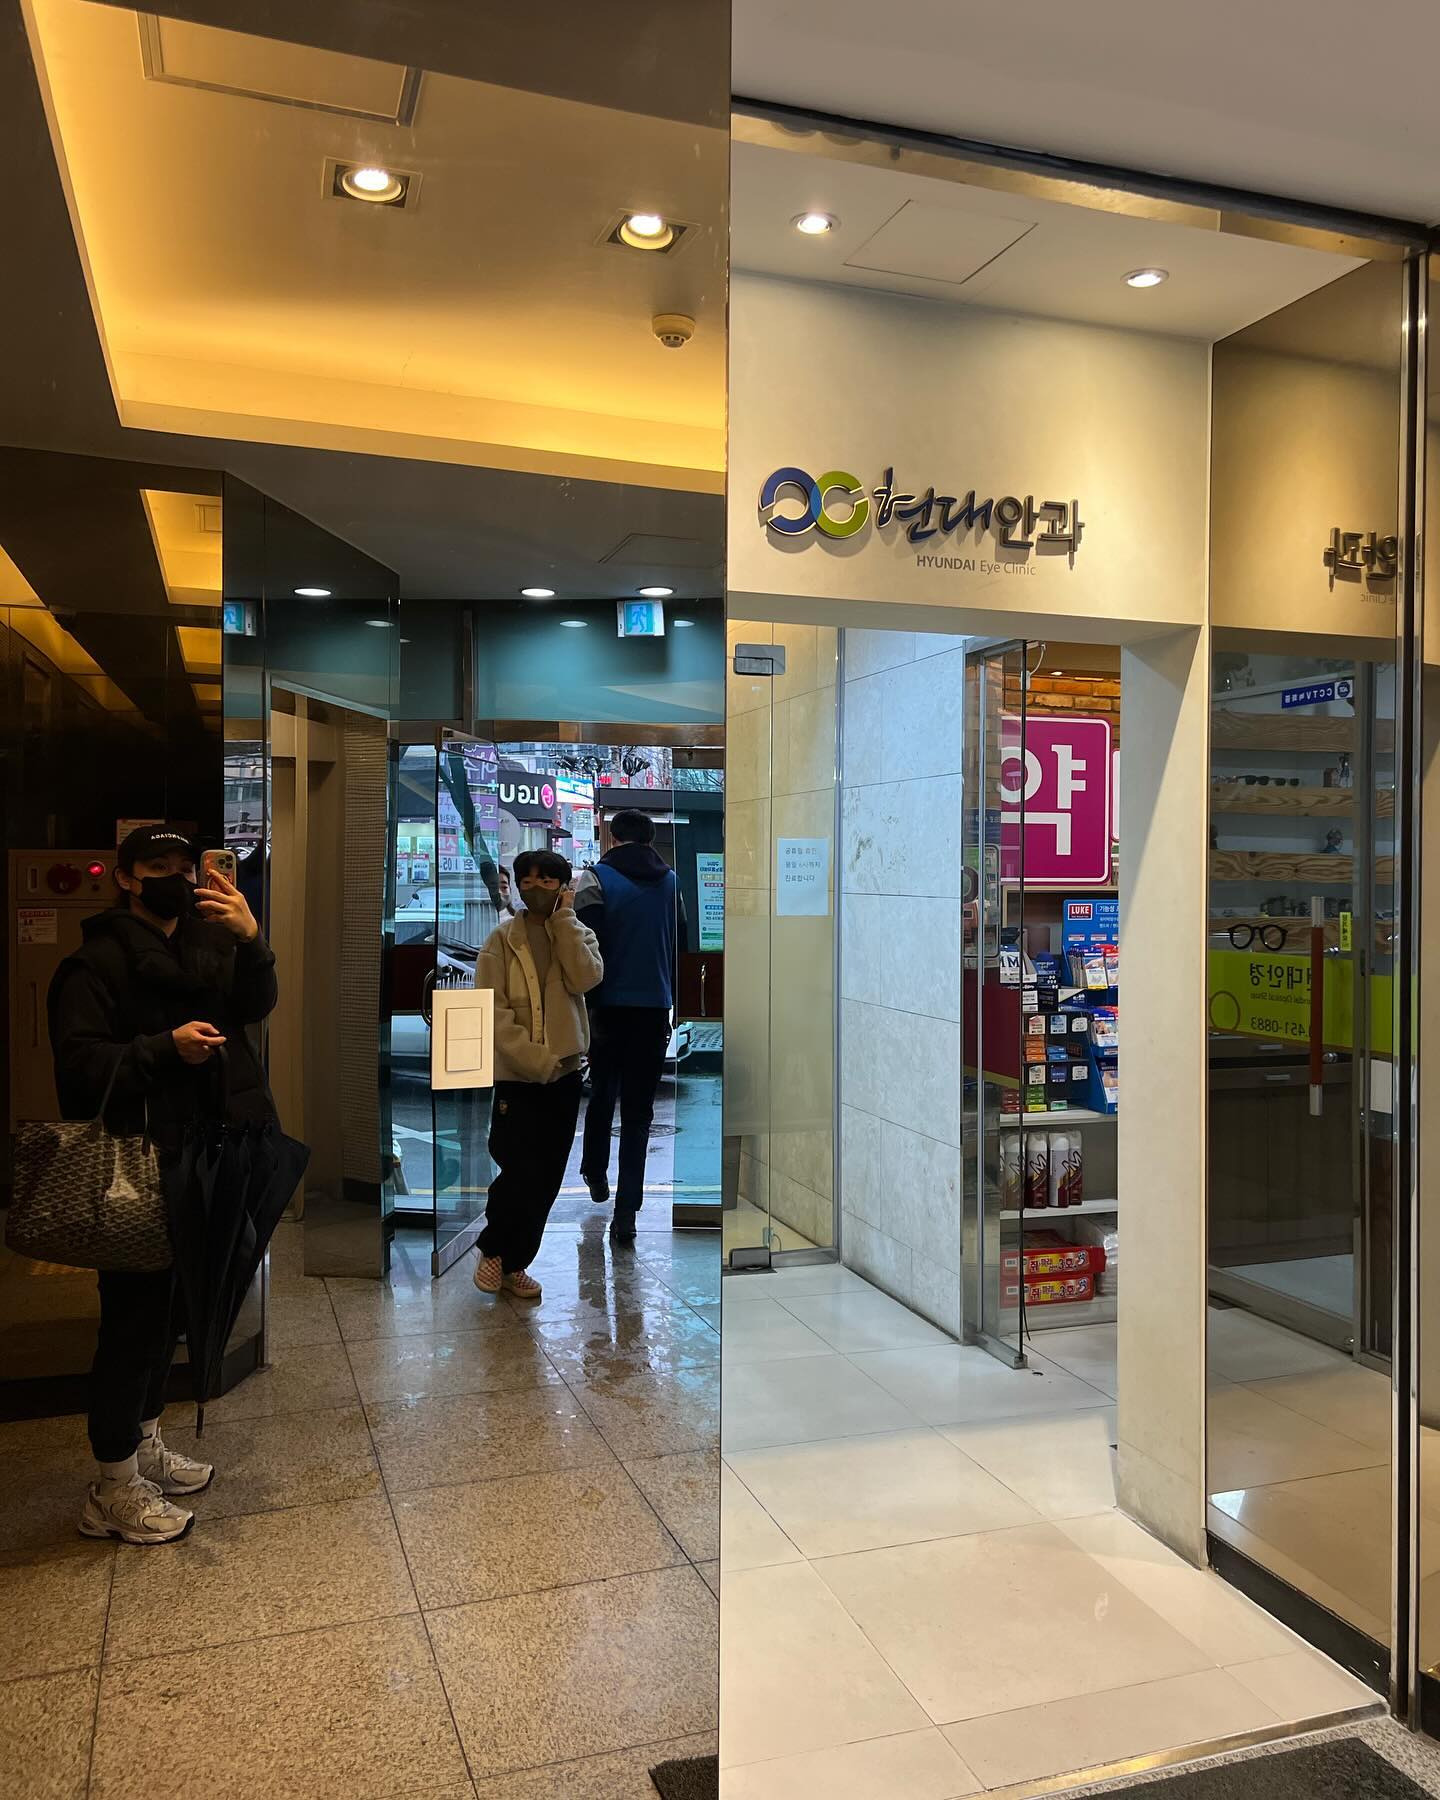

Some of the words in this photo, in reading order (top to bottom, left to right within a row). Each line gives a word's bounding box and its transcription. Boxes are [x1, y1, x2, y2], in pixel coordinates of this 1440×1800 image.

[874, 466, 1085, 553] 현대안과
[916, 554, 976, 572] HYUNDAI
[979, 559, 1000, 576] Eye
[1003, 560, 1036, 577] Clinic
[1071, 905, 1090, 915] LUKE
